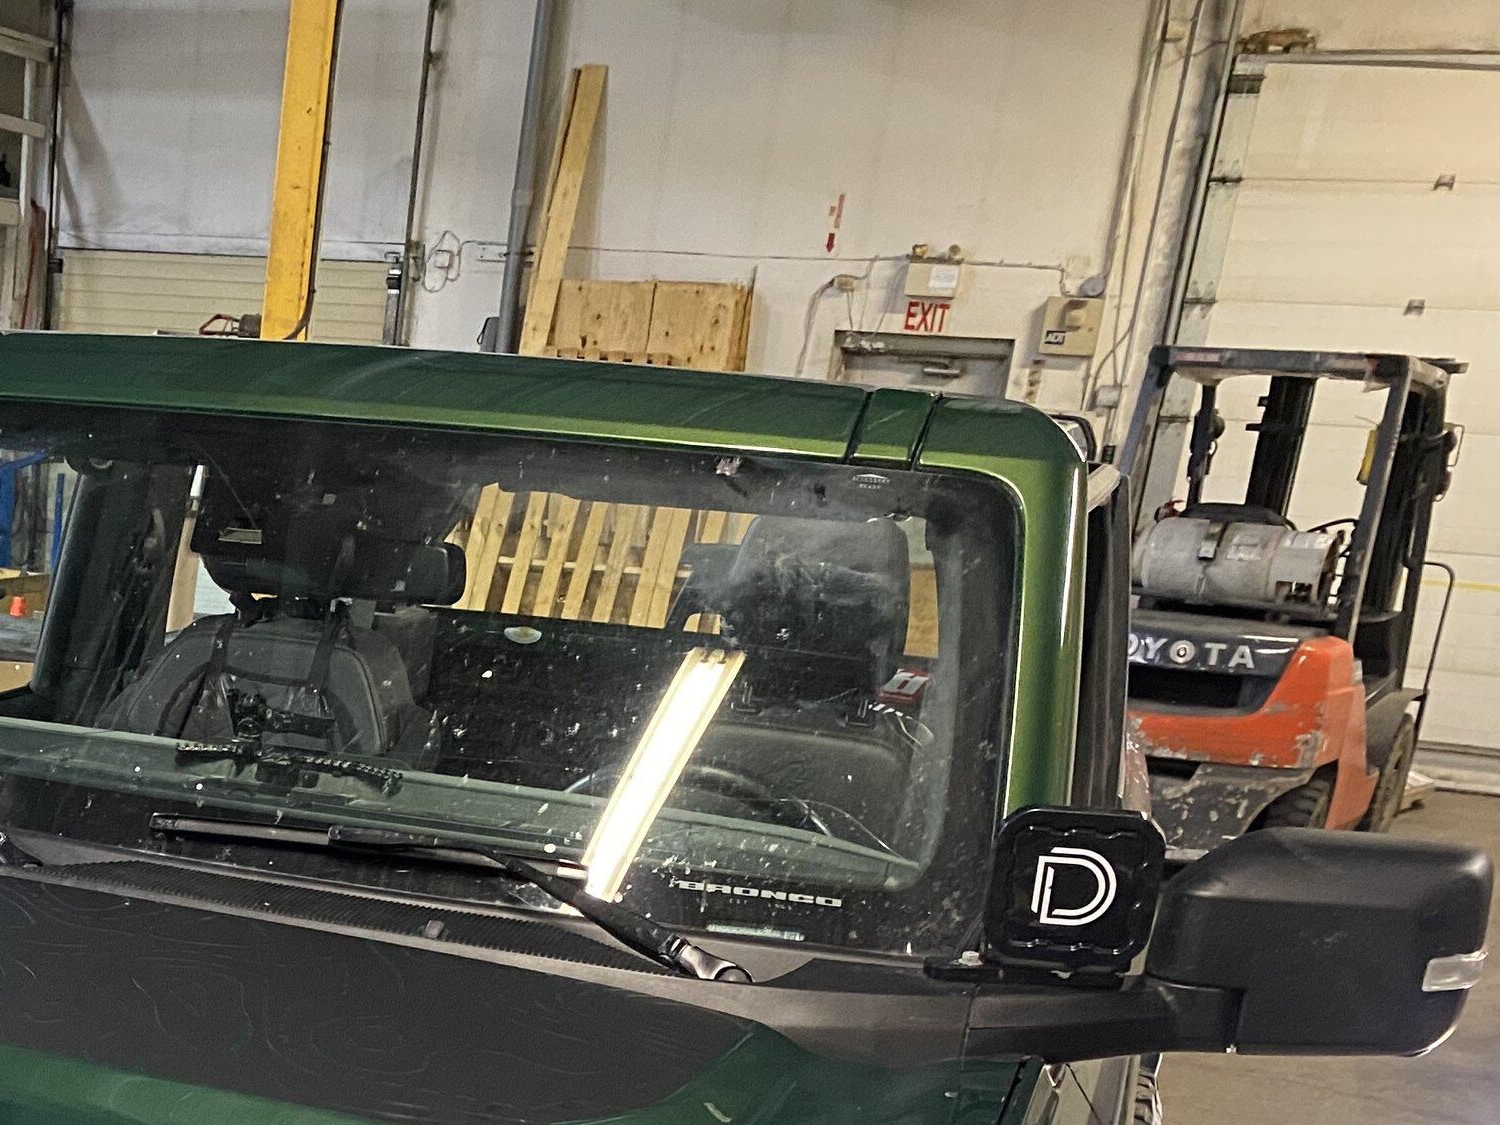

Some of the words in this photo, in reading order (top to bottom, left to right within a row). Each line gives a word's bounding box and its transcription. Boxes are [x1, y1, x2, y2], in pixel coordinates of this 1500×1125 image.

[904, 301, 951, 332] EXIT
[678, 880, 842, 908] BRONCO
[1031, 846, 1117, 926] D
